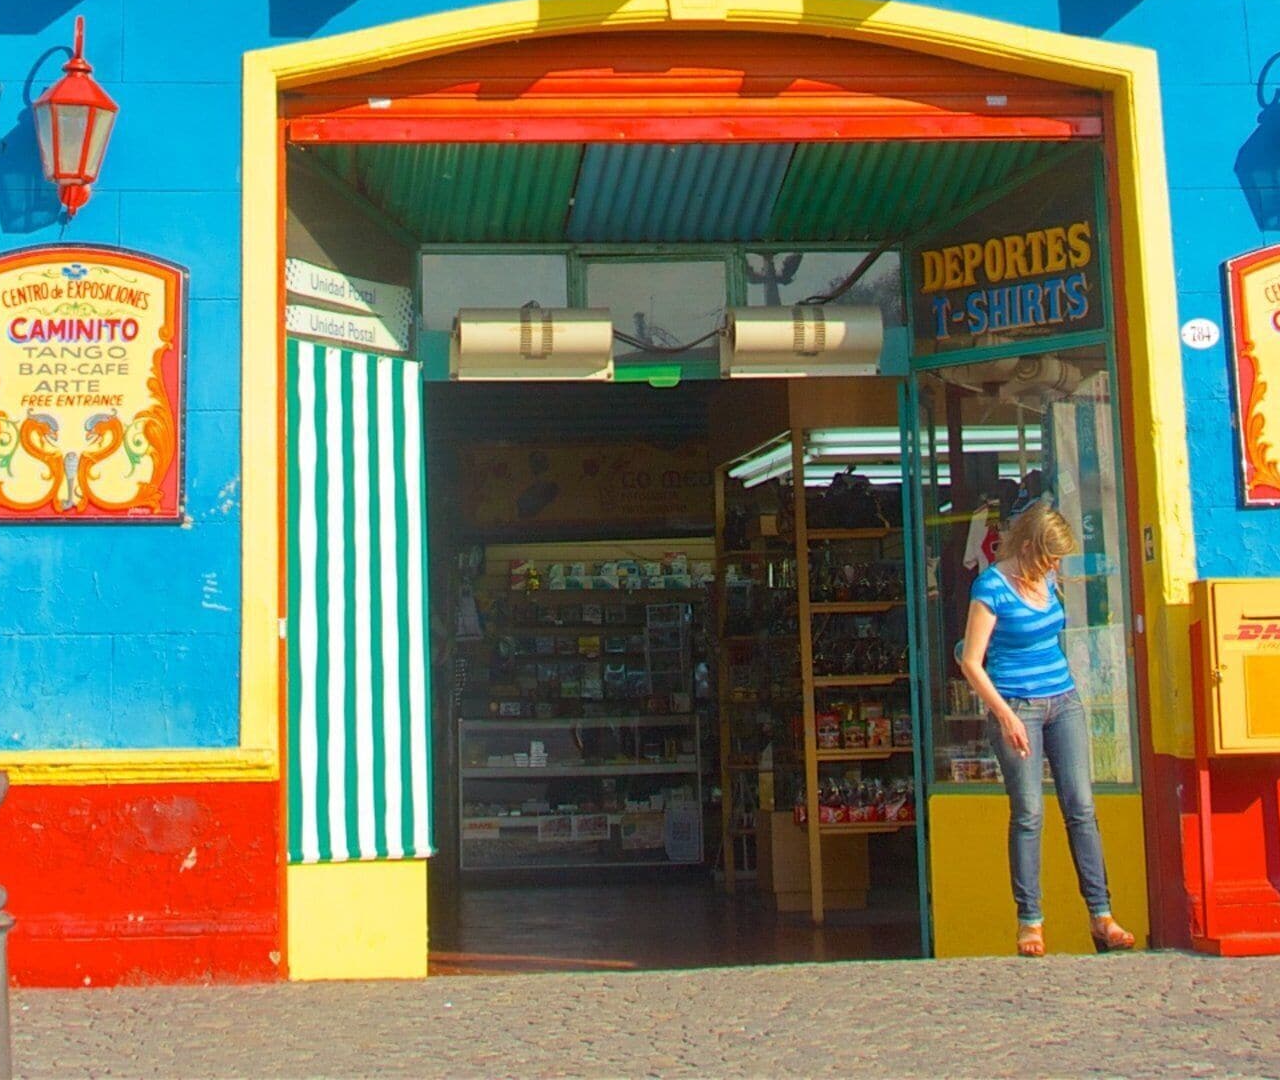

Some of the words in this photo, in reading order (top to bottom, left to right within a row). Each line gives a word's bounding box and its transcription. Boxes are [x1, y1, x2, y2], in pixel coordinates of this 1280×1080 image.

[920, 221, 1092, 295] DEPORTES
[1, 282, 49, 309] CENTRO
[51, 283, 64, 300] de
[67, 280, 151, 310] EXPOSICIONES
[310, 273, 345, 298] Unidad
[348, 283, 376, 305] Postal
[932, 272, 1090, 341] T-SHIRTS
[9, 317, 139, 343] CAMINITO
[310, 314, 345, 337] Unidad
[348, 322, 376, 343] Postal
[23, 346, 127, 359] TANGO
[21, 395, 53, 407] FREE
[57, 394, 124, 406] ENTRANCE
[33, 380, 100, 393] ARTE
